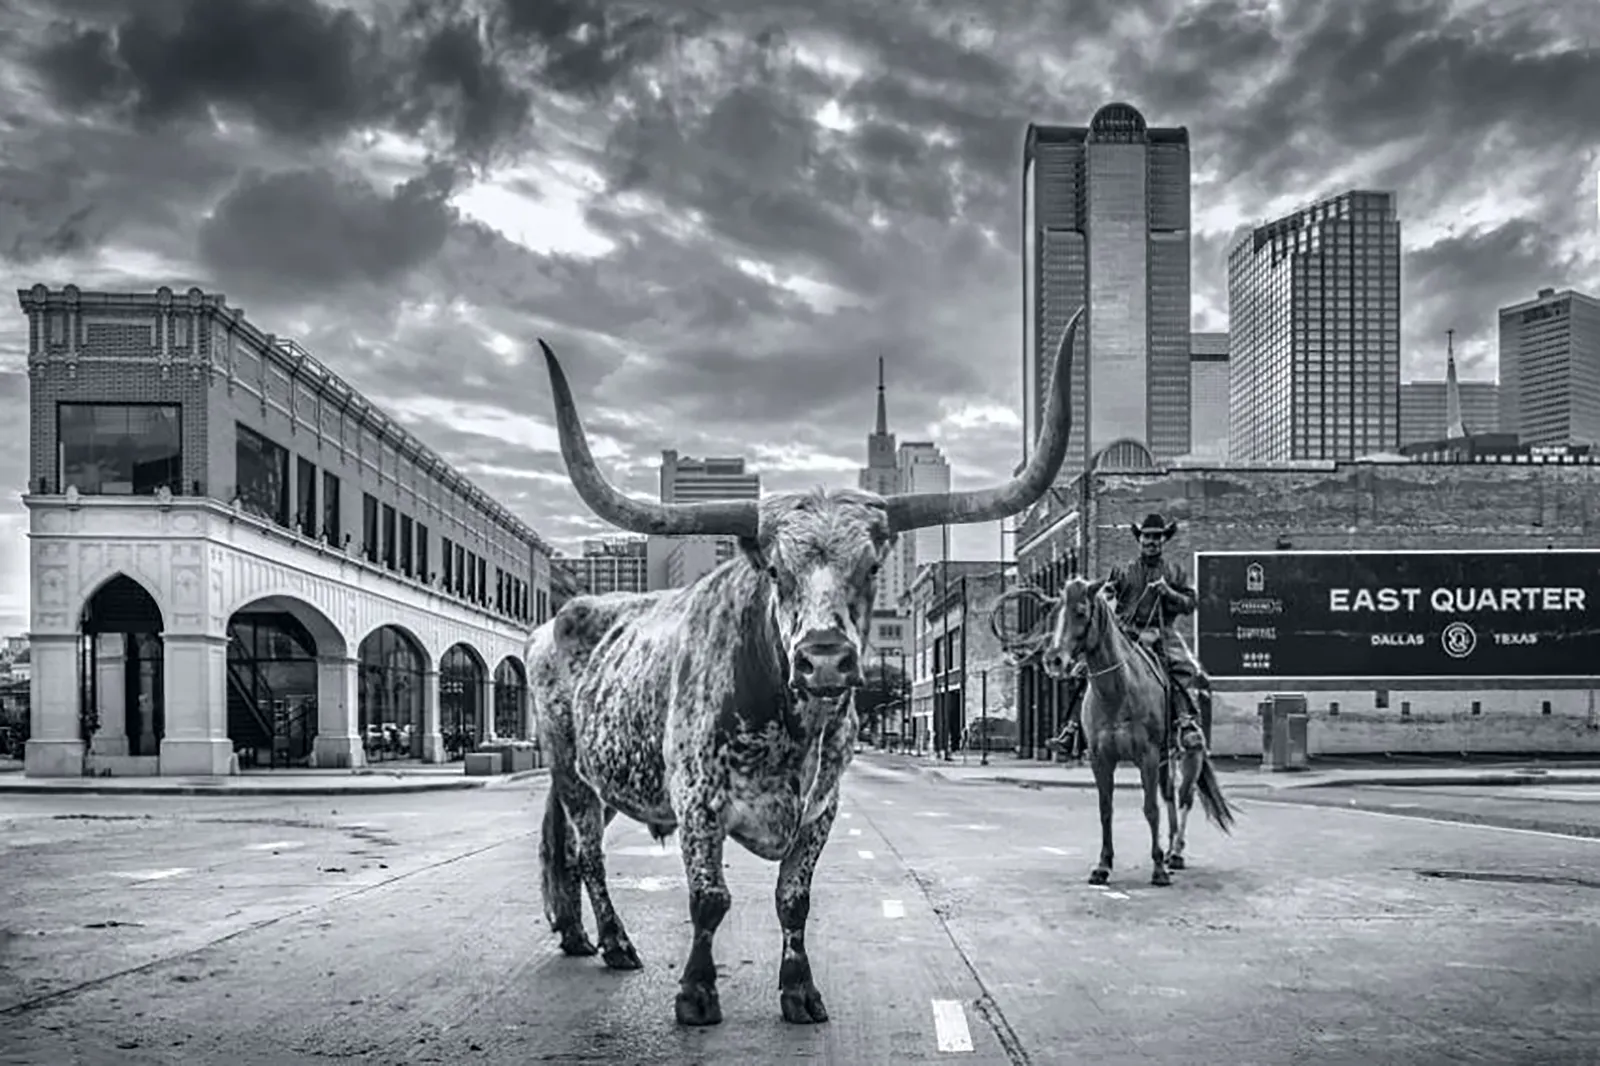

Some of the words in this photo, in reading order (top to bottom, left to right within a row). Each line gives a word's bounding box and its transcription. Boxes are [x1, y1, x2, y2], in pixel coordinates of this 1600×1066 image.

[1330, 587, 1422, 612] EAST
[1430, 587, 1586, 613] QUARTER
[1370, 633, 1425, 647] DALLAS
[1493, 632, 1539, 646] TEXAS
